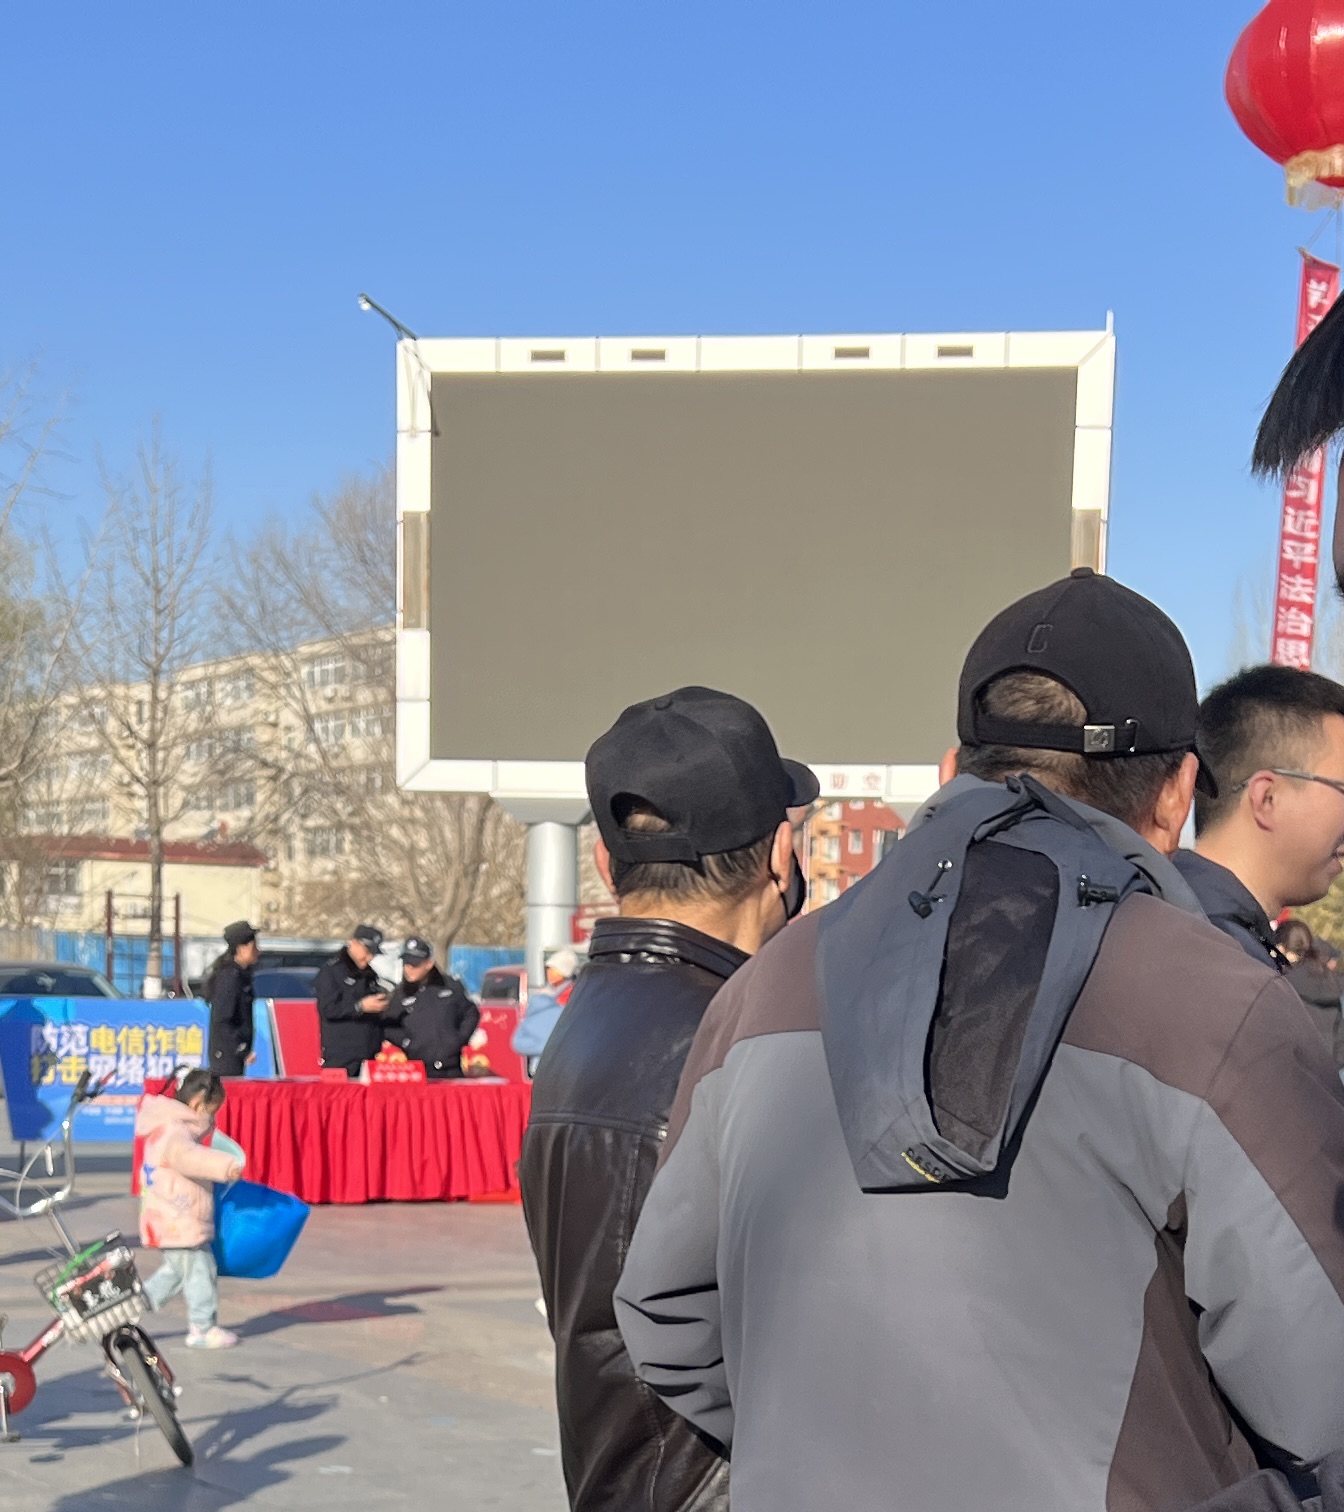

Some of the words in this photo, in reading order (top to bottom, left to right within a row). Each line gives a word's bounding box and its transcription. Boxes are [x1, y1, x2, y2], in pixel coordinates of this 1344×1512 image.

[30, 1022, 204, 1057] 防范电信诈骗
